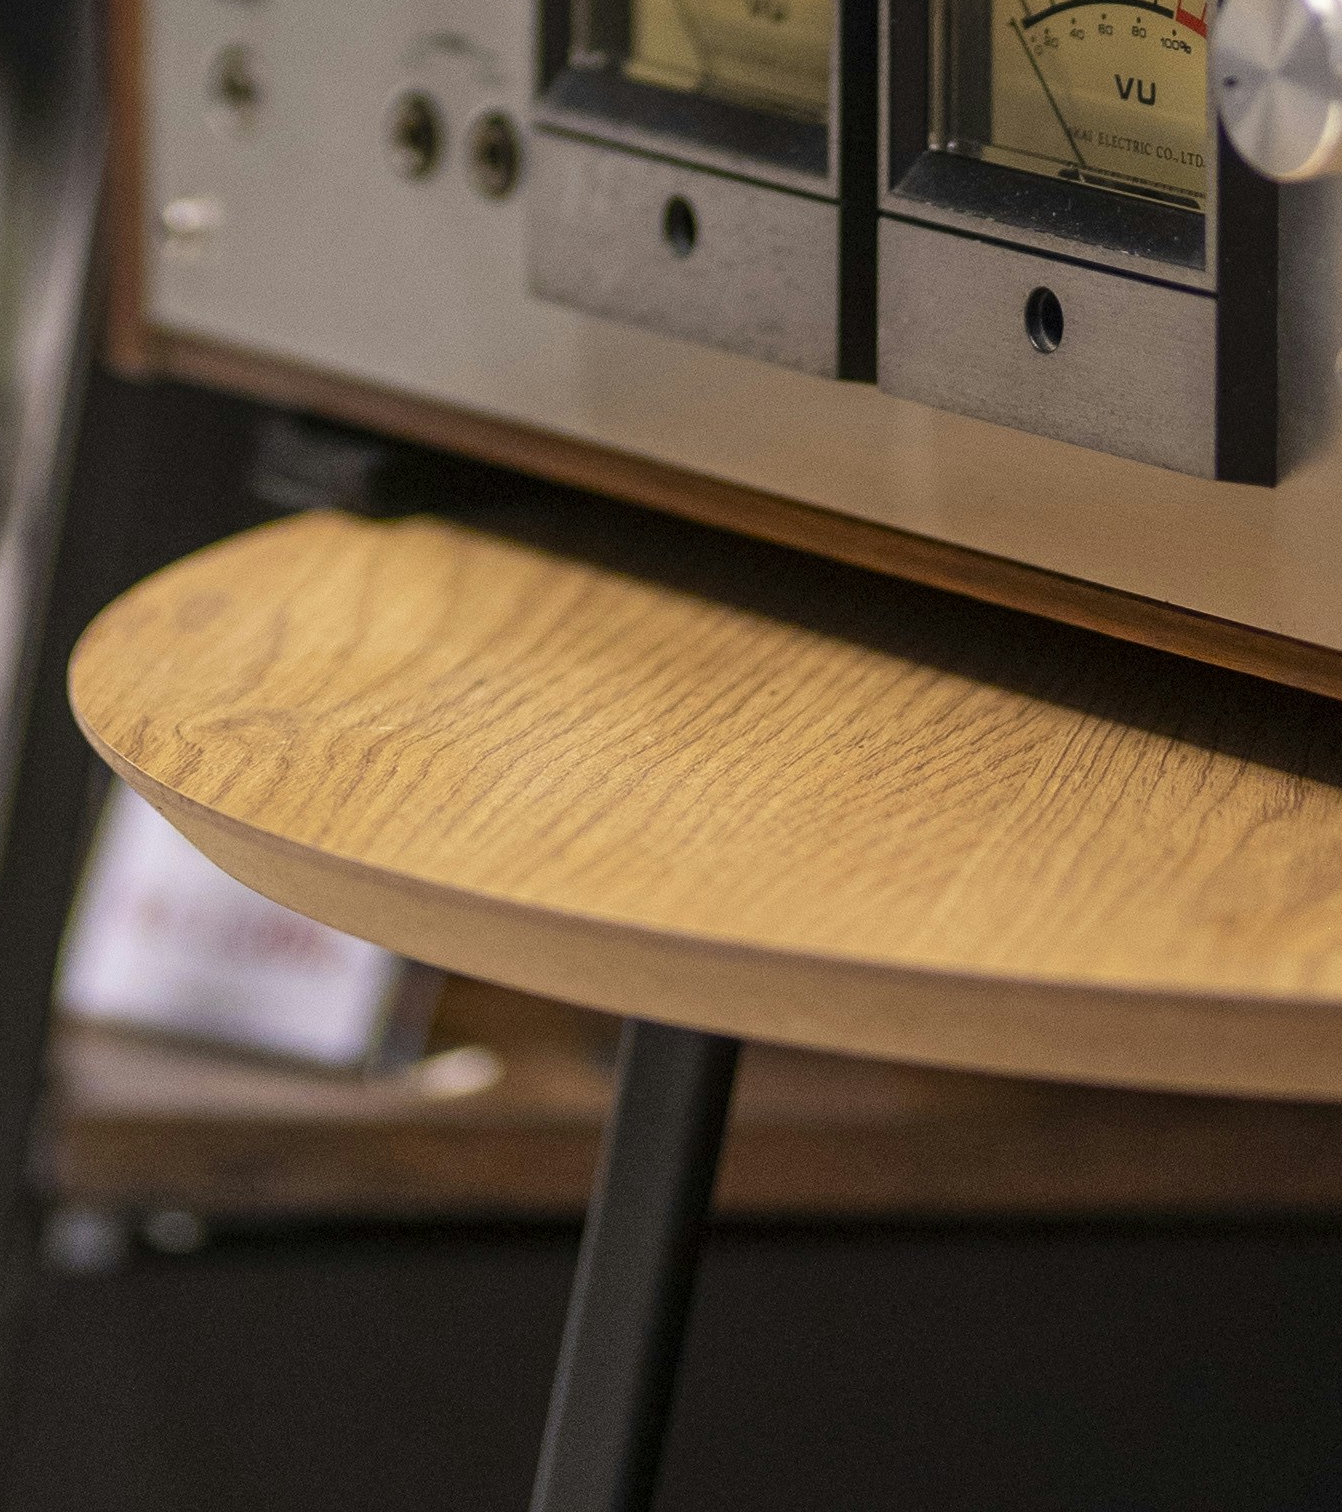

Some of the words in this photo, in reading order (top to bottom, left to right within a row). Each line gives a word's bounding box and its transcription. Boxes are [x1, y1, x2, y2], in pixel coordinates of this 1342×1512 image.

[1160, 37, 1192, 55] 100%
[1115, 74, 1157, 106] VU
[1098, 132, 1152, 156] ELECTRIC
